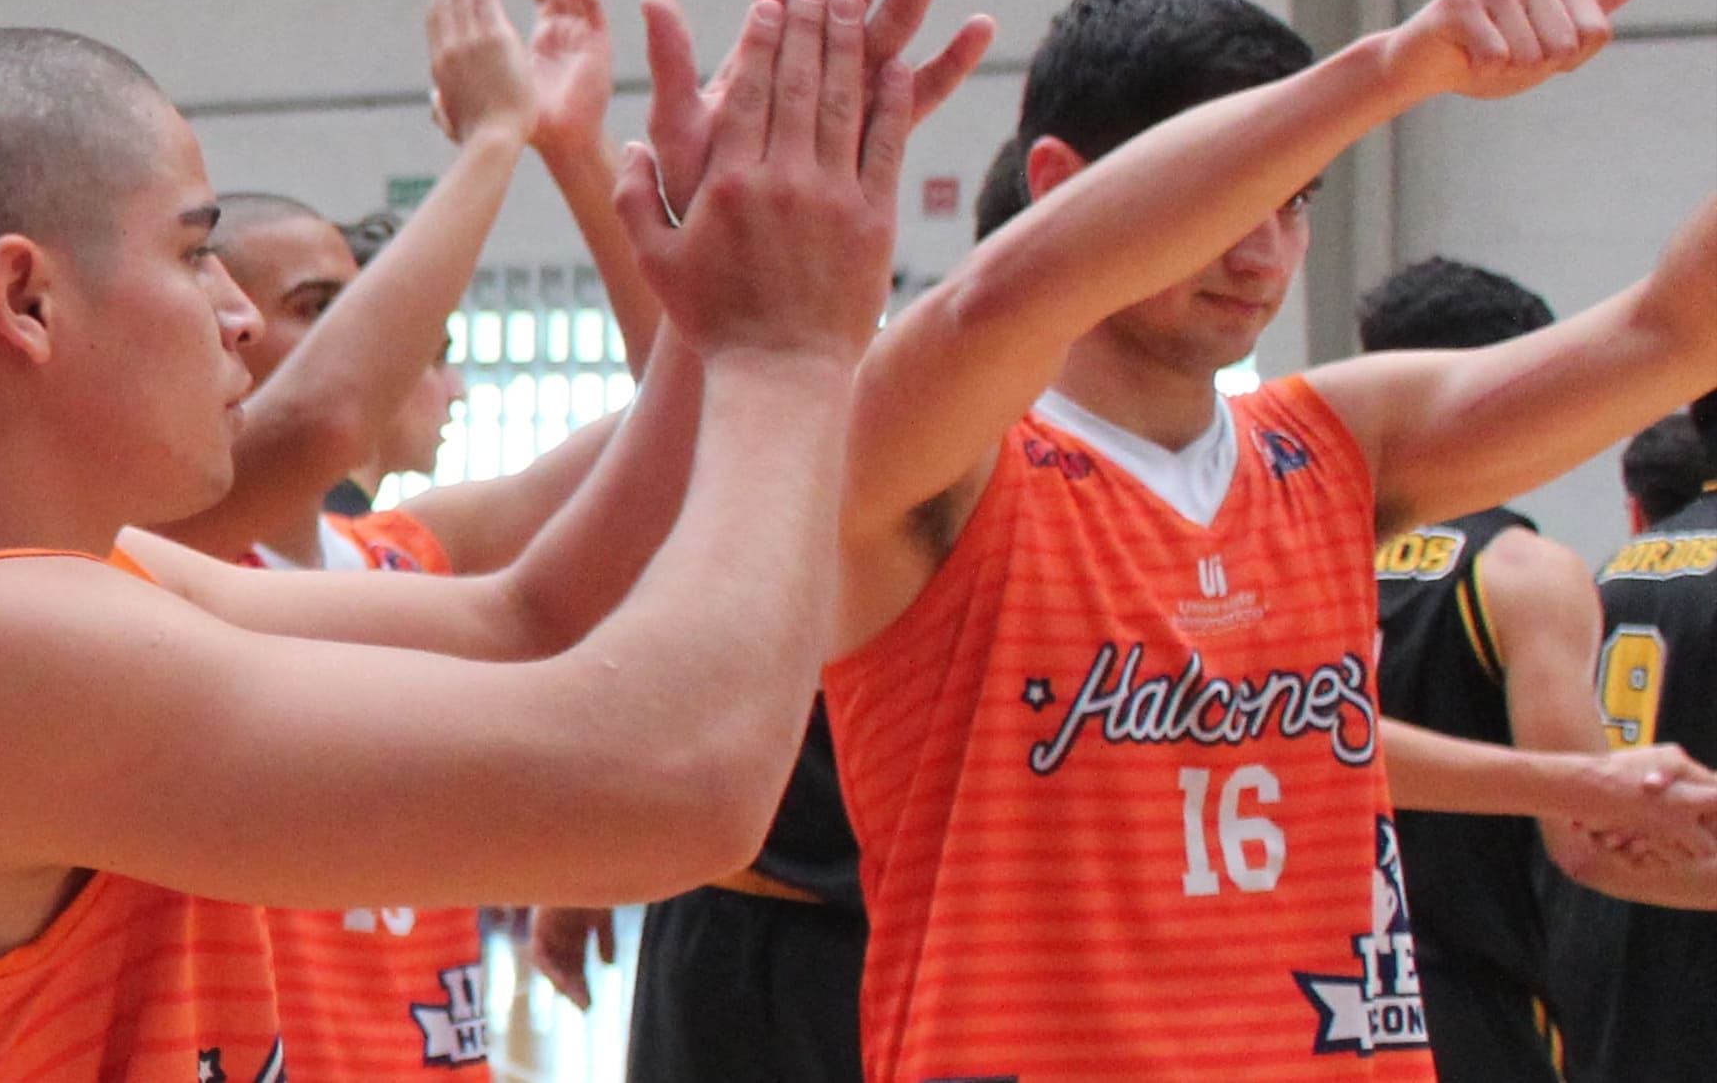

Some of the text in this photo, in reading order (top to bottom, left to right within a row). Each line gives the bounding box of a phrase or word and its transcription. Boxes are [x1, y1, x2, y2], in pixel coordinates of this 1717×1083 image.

[1029, 642, 1377, 775] Halcones
[1595, 623, 1669, 759] 9
[1178, 764, 1286, 897] 16
